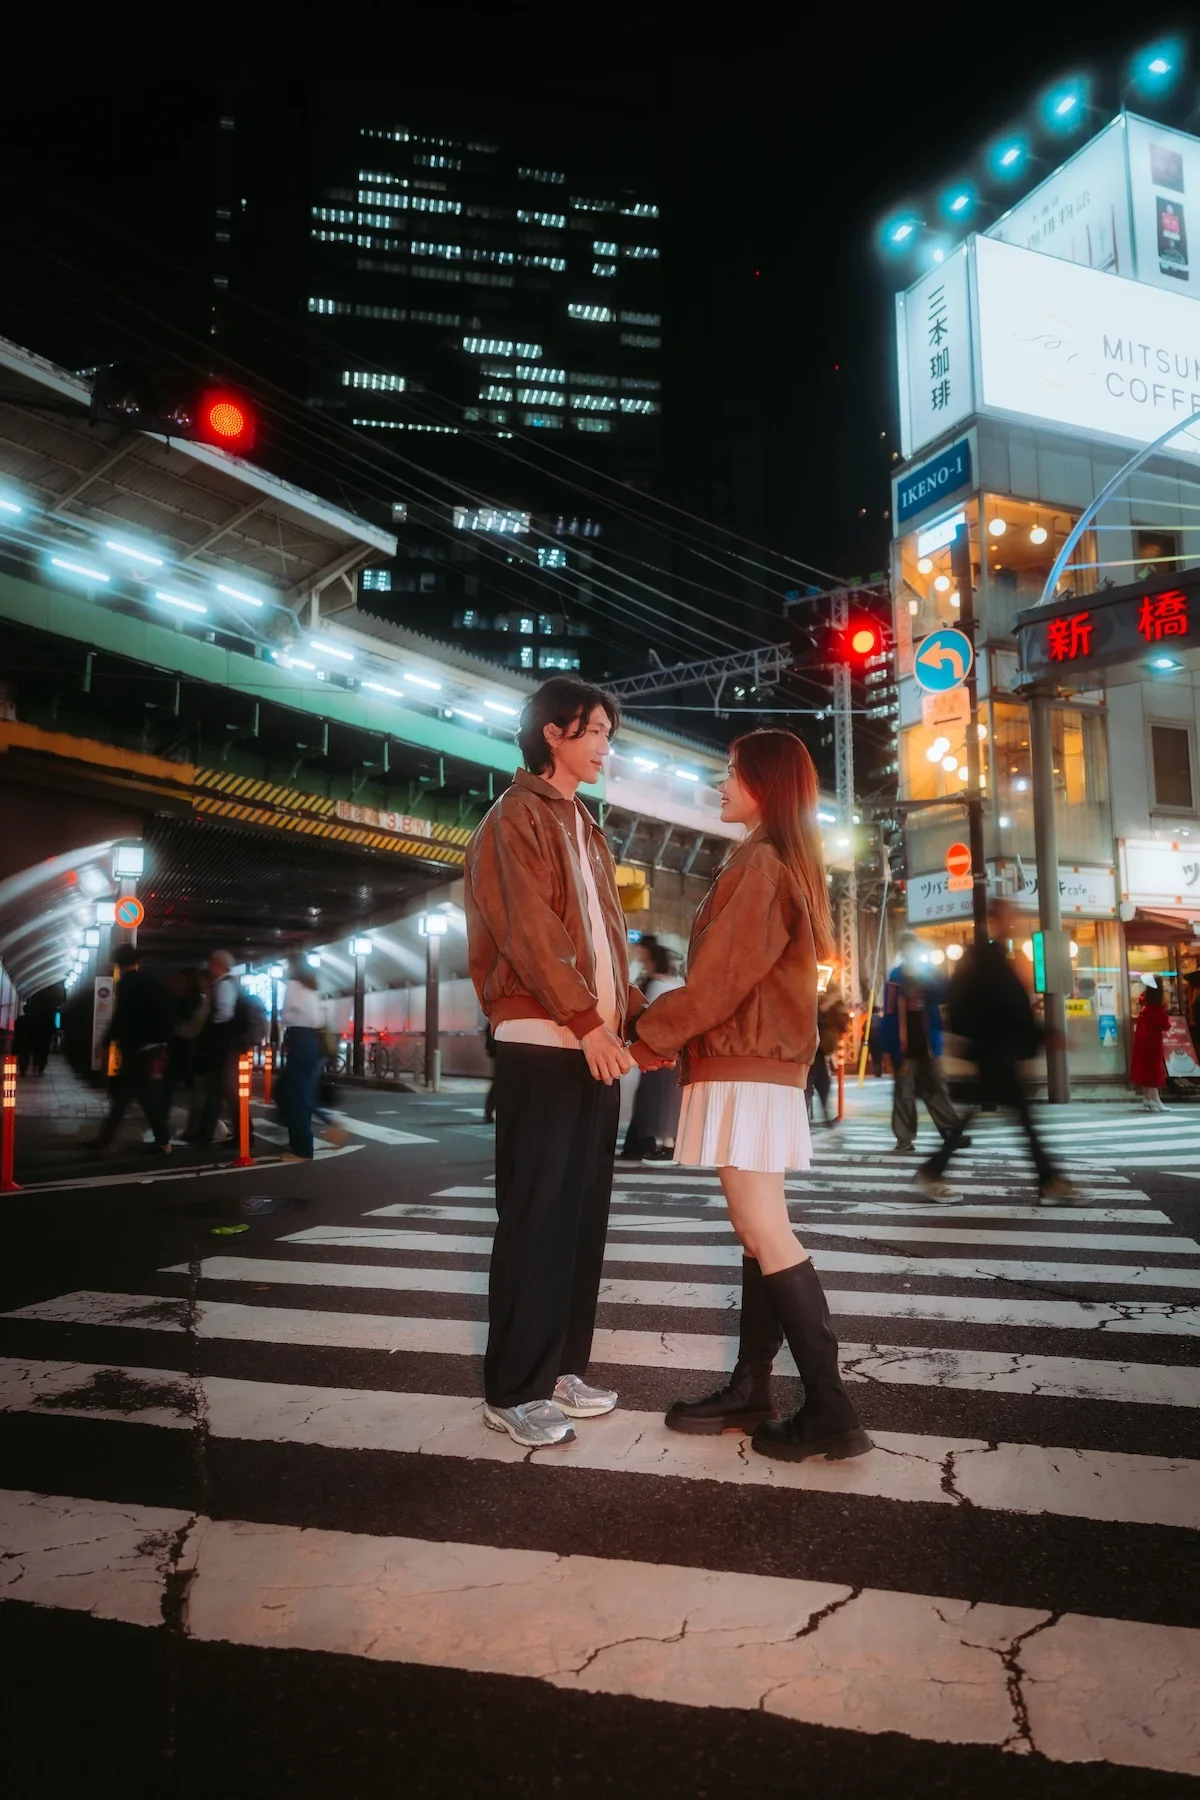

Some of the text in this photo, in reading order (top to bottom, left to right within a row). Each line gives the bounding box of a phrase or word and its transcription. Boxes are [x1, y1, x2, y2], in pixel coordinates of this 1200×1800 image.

[928, 284, 950, 411] 三本珈琲
[902, 456, 963, 509] IKENO-1
[1047, 589, 1189, 662] 新橋
